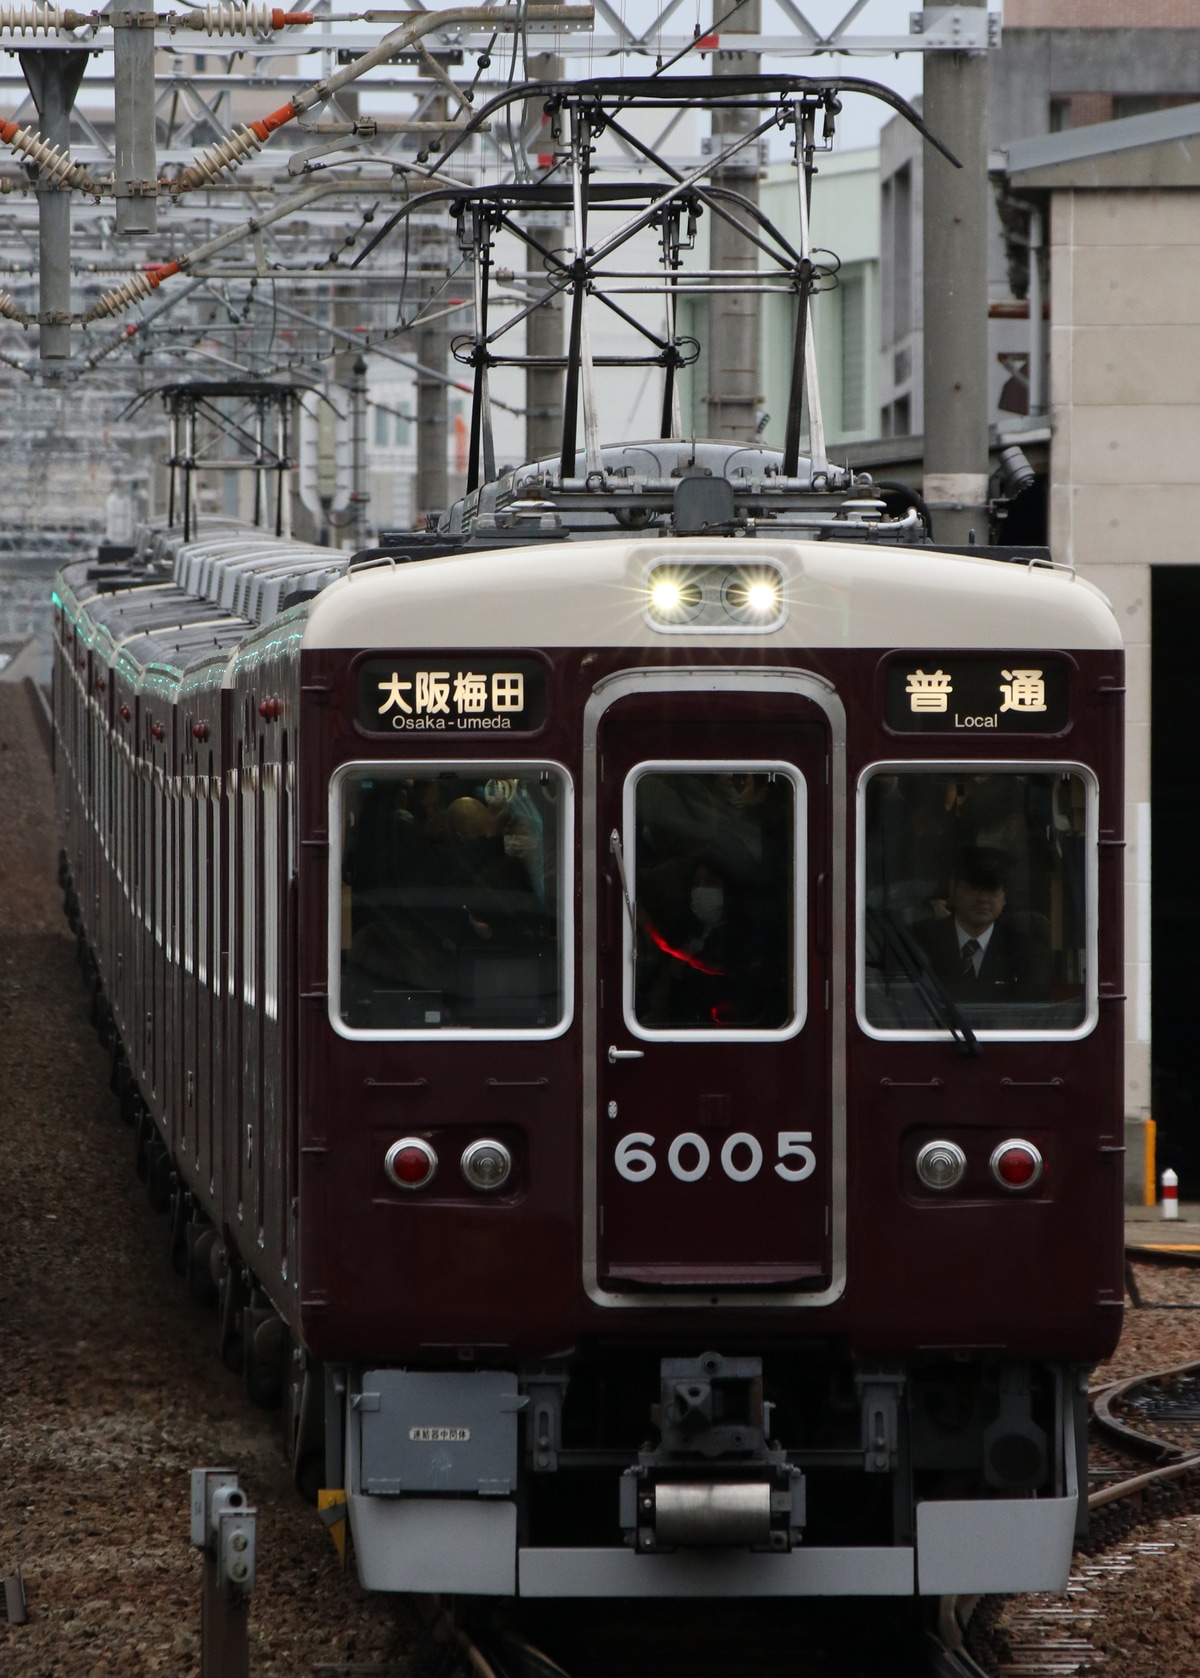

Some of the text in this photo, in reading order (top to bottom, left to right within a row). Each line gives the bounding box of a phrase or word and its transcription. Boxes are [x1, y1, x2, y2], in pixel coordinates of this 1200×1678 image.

[378, 671, 525, 714] 大阪梅田
[905, 669, 1047, 712] 普通
[392, 714, 511, 729] Osaka-umeda
[955, 713, 998, 728] Local
[614, 1131, 817, 1182] 6005
